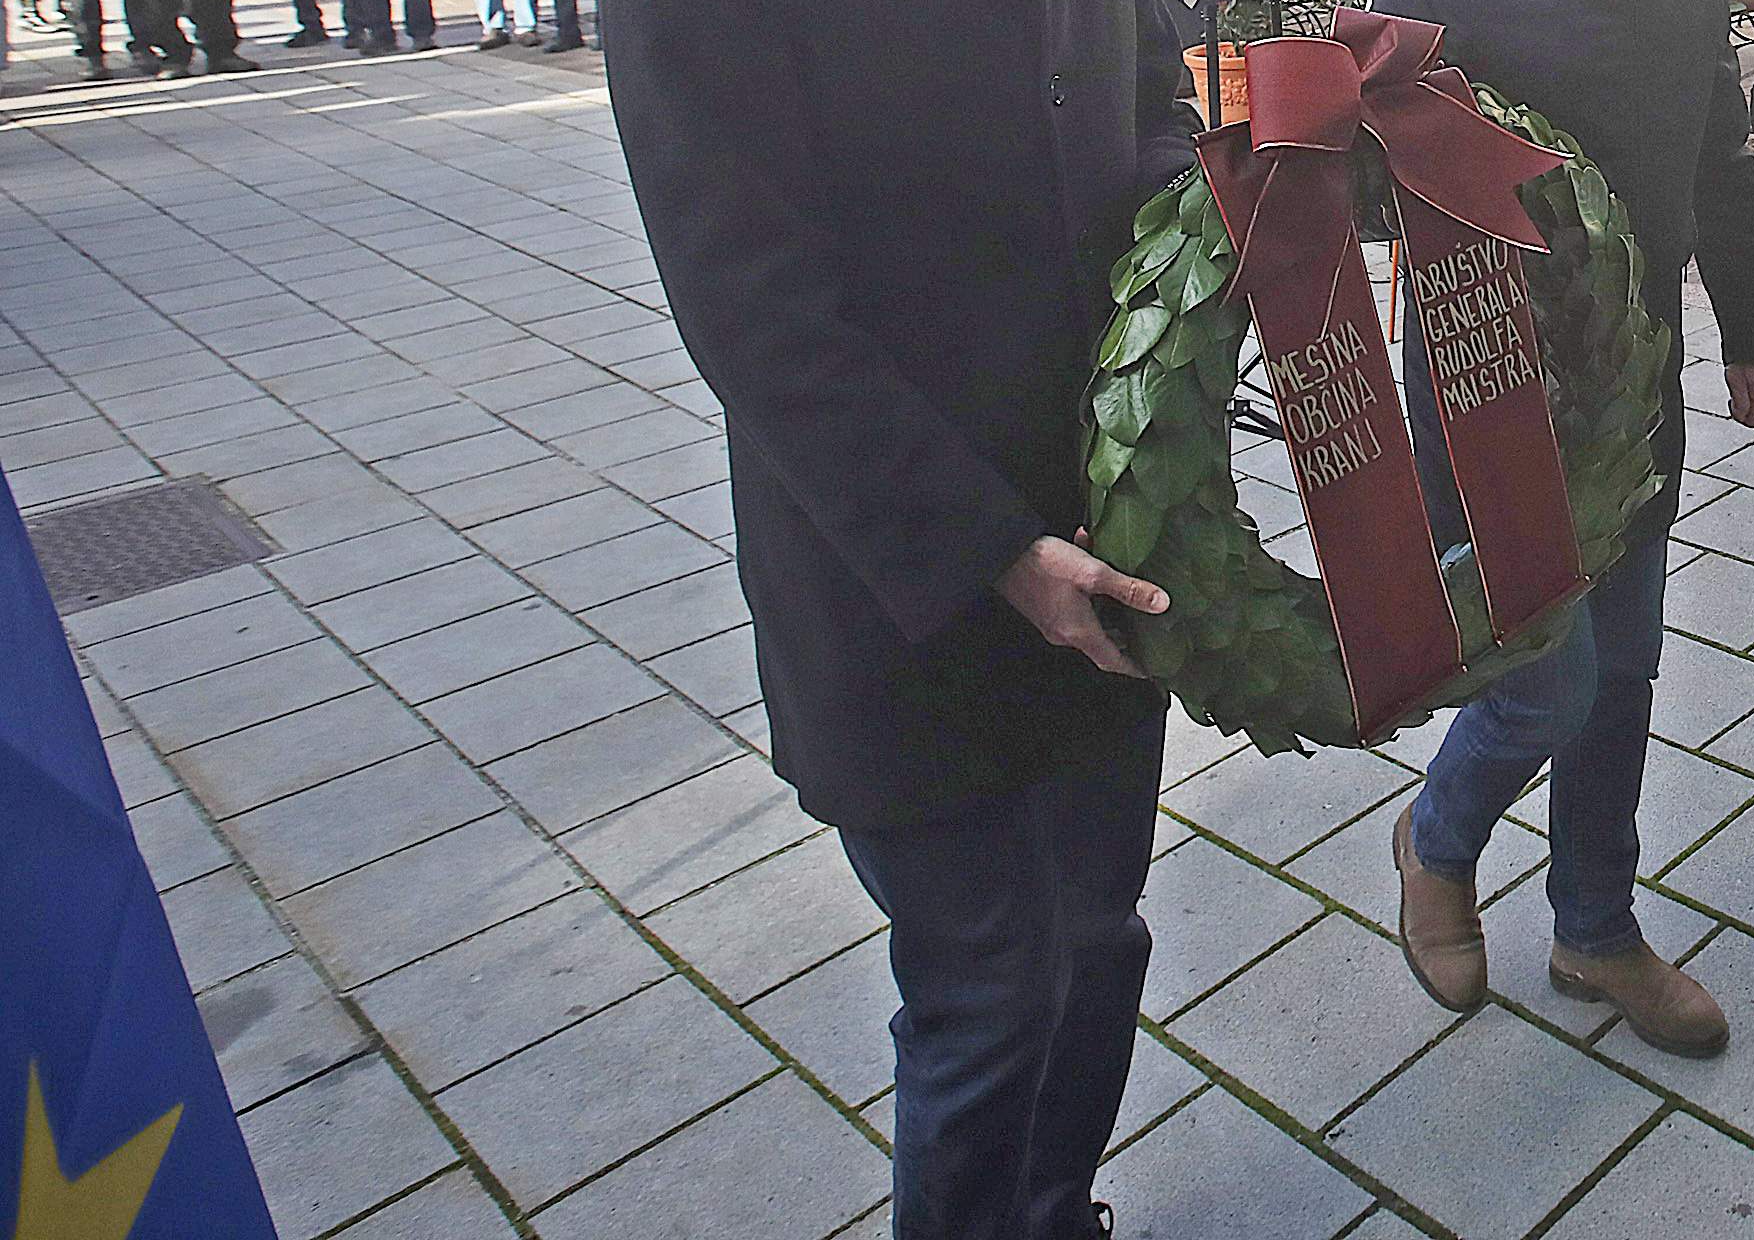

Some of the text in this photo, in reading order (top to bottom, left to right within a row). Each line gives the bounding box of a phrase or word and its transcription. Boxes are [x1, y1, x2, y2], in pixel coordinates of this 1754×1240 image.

[1415, 237, 1510, 303] DRUŠTVO
[1426, 272, 1525, 343] GENERALA
[1269, 319, 1368, 400] MESTNA
[1435, 314, 1523, 380] RUDOLFA
[1285, 367, 1378, 444] OBČINA
[1442, 348, 1536, 421] MAISTRA
[1298, 417, 1382, 492] KRANJ
